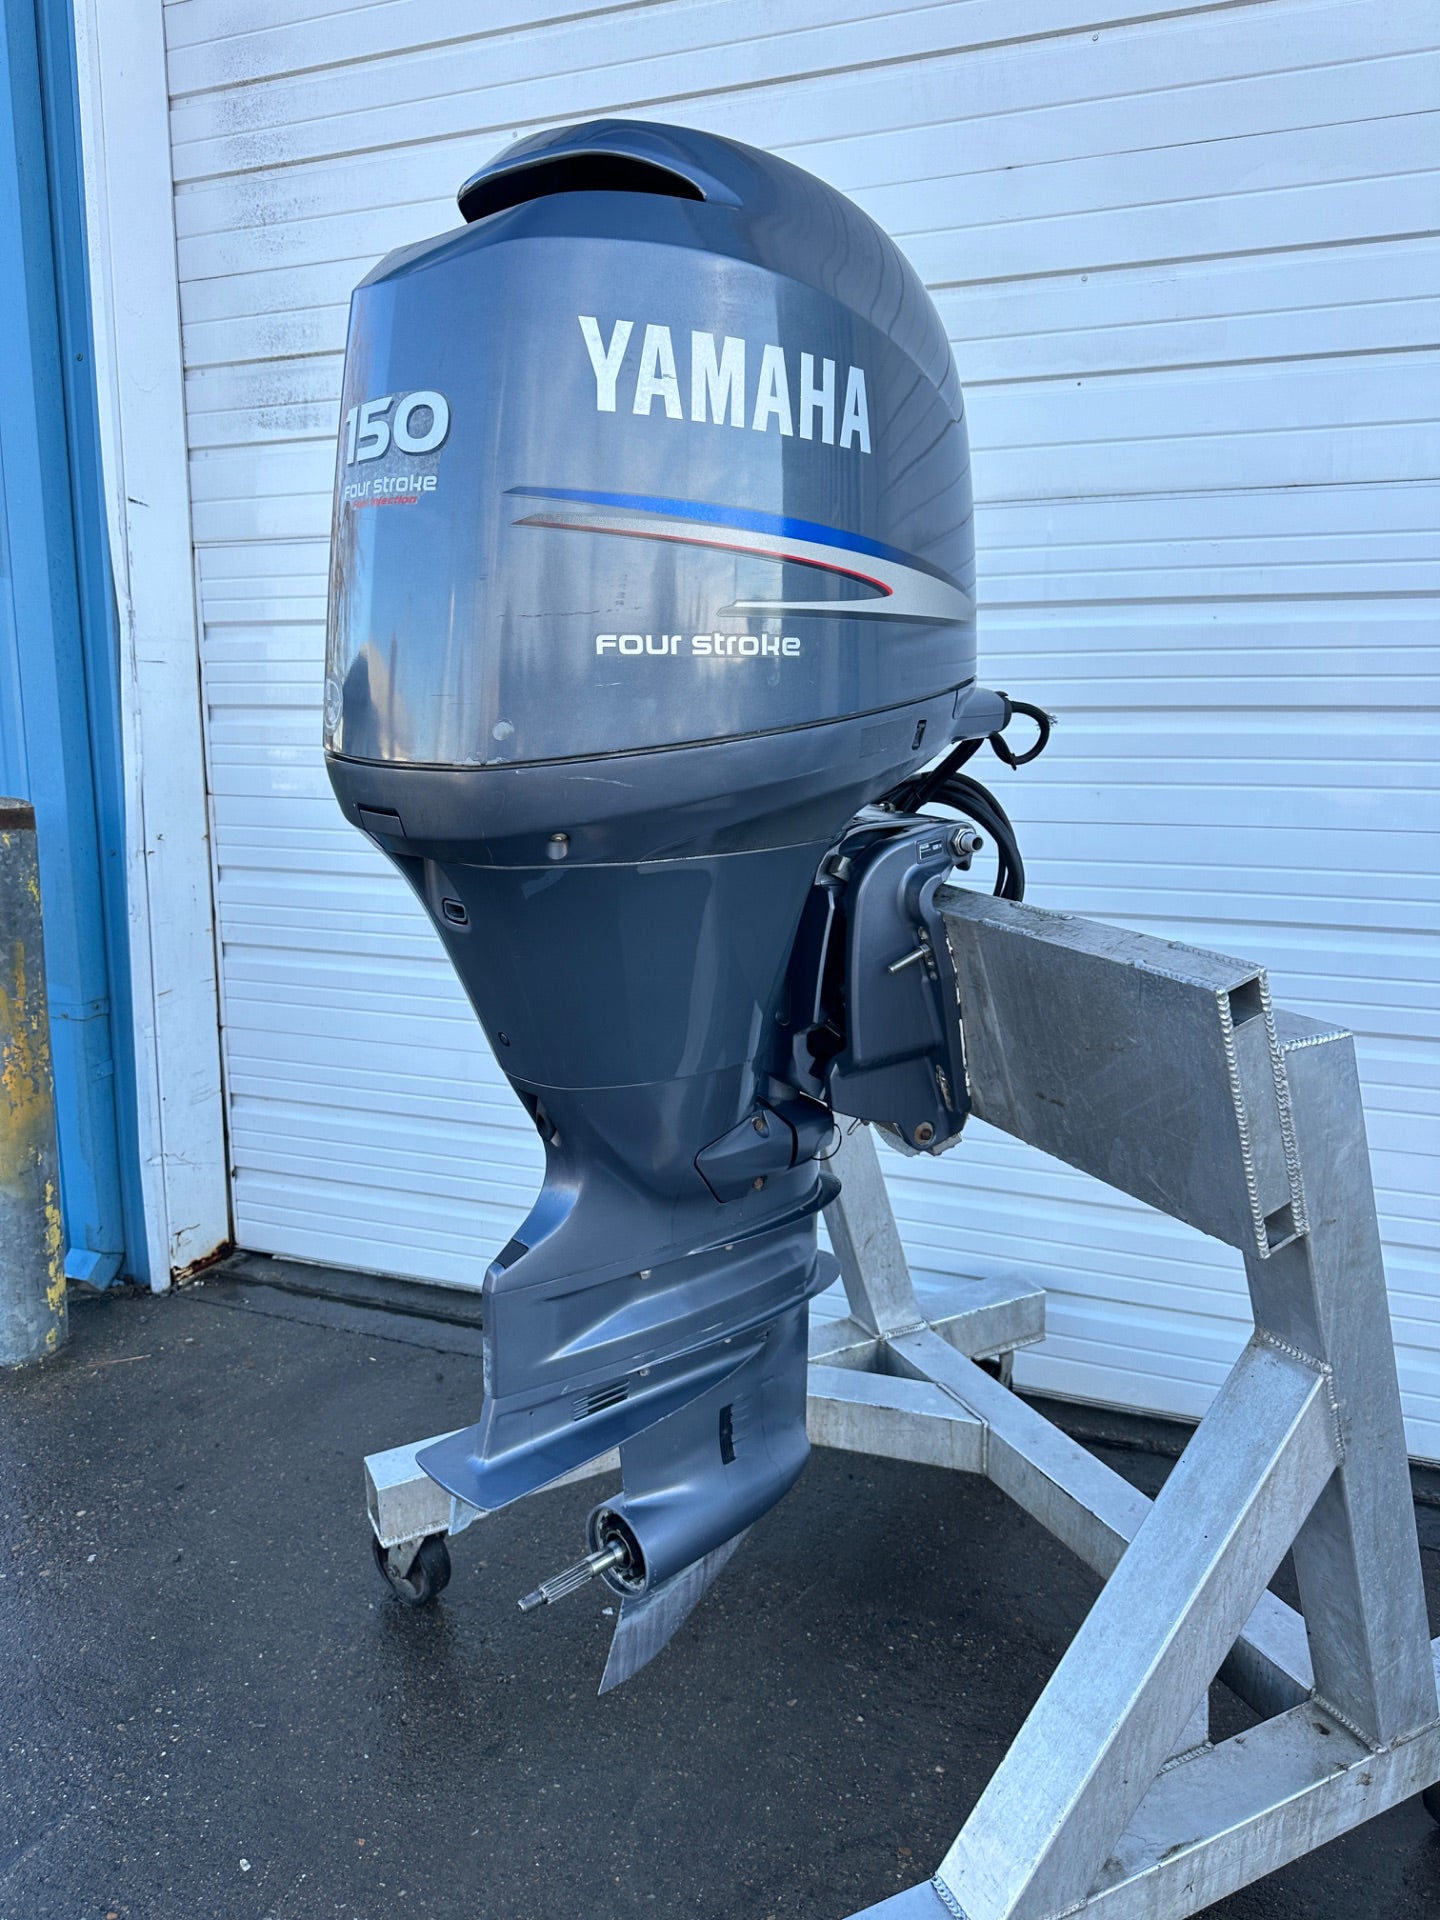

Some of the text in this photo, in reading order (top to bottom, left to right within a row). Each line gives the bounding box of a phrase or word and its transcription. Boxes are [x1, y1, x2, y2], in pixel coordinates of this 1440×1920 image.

[578, 315, 871, 454] YAMAHA
[345, 391, 451, 467] 150
[373, 474, 437, 494] stroke
[692, 632, 801, 656] stroke
